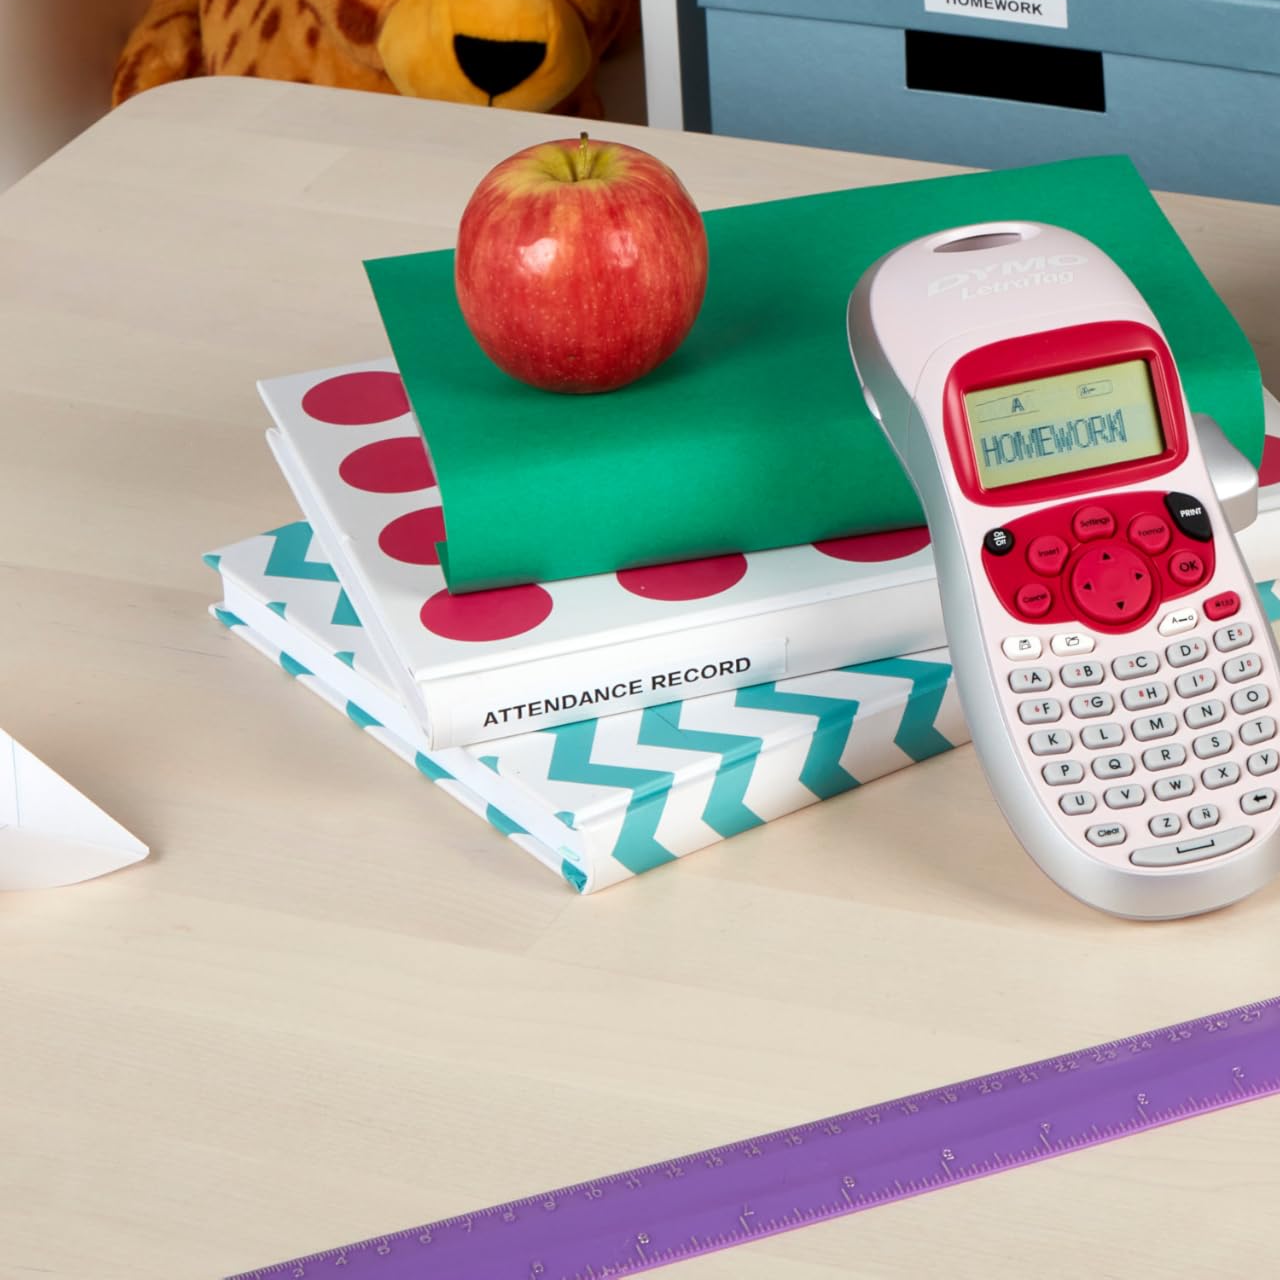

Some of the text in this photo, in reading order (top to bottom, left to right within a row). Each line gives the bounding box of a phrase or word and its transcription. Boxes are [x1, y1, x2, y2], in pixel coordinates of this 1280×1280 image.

[927, 254, 1089, 297] DYMO
[961, 270, 1074, 301] LetraTag
[1011, 397, 1025, 413] A
[980, 409, 1126, 467] HOMEWORK
[1179, 507, 1202, 518] PRINT
[1179, 560, 1199, 572] OK
[1227, 629, 1237, 641] E
[1180, 644, 1191, 656] D
[1136, 656, 1148, 668] C
[1238, 661, 1246, 673] J
[1075, 665, 1094, 677] 2 B
[1030, 672, 1042, 684] A
[1192, 676, 1198, 688] I
[482, 657, 752, 727] ATTENDANCE RECORD
[1145, 687, 1158, 699] H
[1247, 690, 1260, 702] O
[1090, 696, 1104, 708] G
[1042, 703, 1051, 715] F
[1201, 705, 1214, 718] N
[1149, 718, 1165, 731] M
[1254, 722, 1265, 734] T
[1047, 733, 1059, 746] K
[1099, 729, 1109, 741] L
[1211, 737, 1220, 748] S
[1161, 749, 1171, 761] R
[1260, 754, 1270, 766] Y
[1060, 765, 1070, 776] P
[1108, 759, 1121, 770] Q
[1218, 767, 1229, 779] X
[1169, 779, 1182, 791] W
[1075, 795, 1085, 806] U
[1120, 789, 1131, 800] V
[1201, 808, 1211, 820] Ñ
[1162, 818, 1172, 829] Z
[1097, 827, 1120, 837] Clear
[585, 1188, 602, 1200] 10
[626, 1177, 643, 1189] 11
[666, 1167, 685, 1178] 12
[705, 1156, 724, 1168] 13
[744, 1147, 762, 1158] 14
[978, 1081, 1002, 1094] 20
[1018, 1072, 1039, 1084] 21
[1056, 1061, 1080, 1072] 22
[1093, 1050, 1117, 1063] 23
[1128, 1041, 1152, 1053] 24
[1167, 1030, 1192, 1041] 25
[1204, 1020, 1229, 1033] 26
[1239, 1009, 1262, 1022] 27
